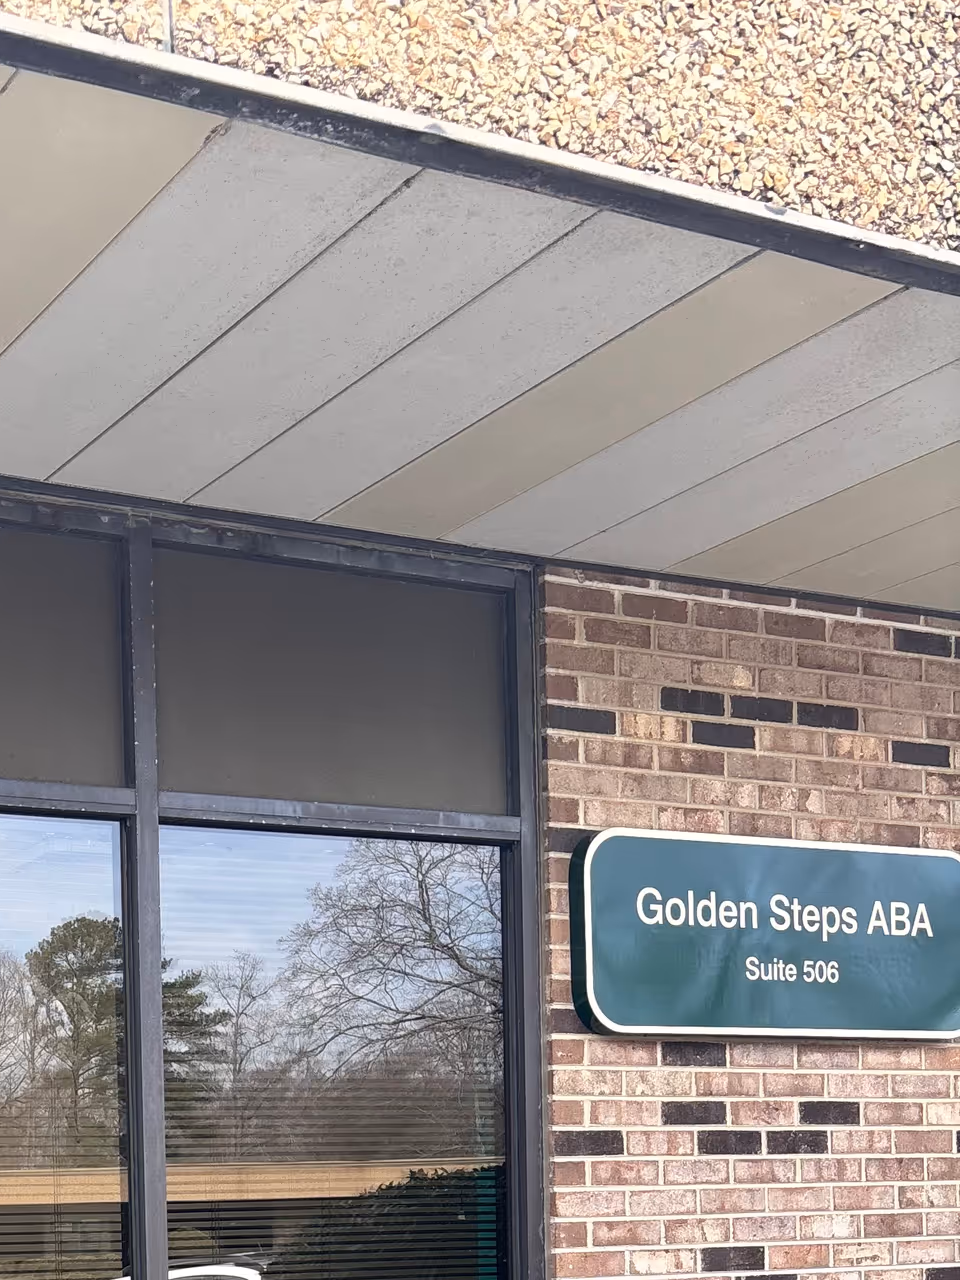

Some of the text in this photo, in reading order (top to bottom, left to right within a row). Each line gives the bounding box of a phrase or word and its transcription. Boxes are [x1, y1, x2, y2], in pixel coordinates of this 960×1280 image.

[636, 886, 934, 942] Golden Steps ABA
[745, 956, 797, 982] Suite
[802, 959, 840, 984] 506
